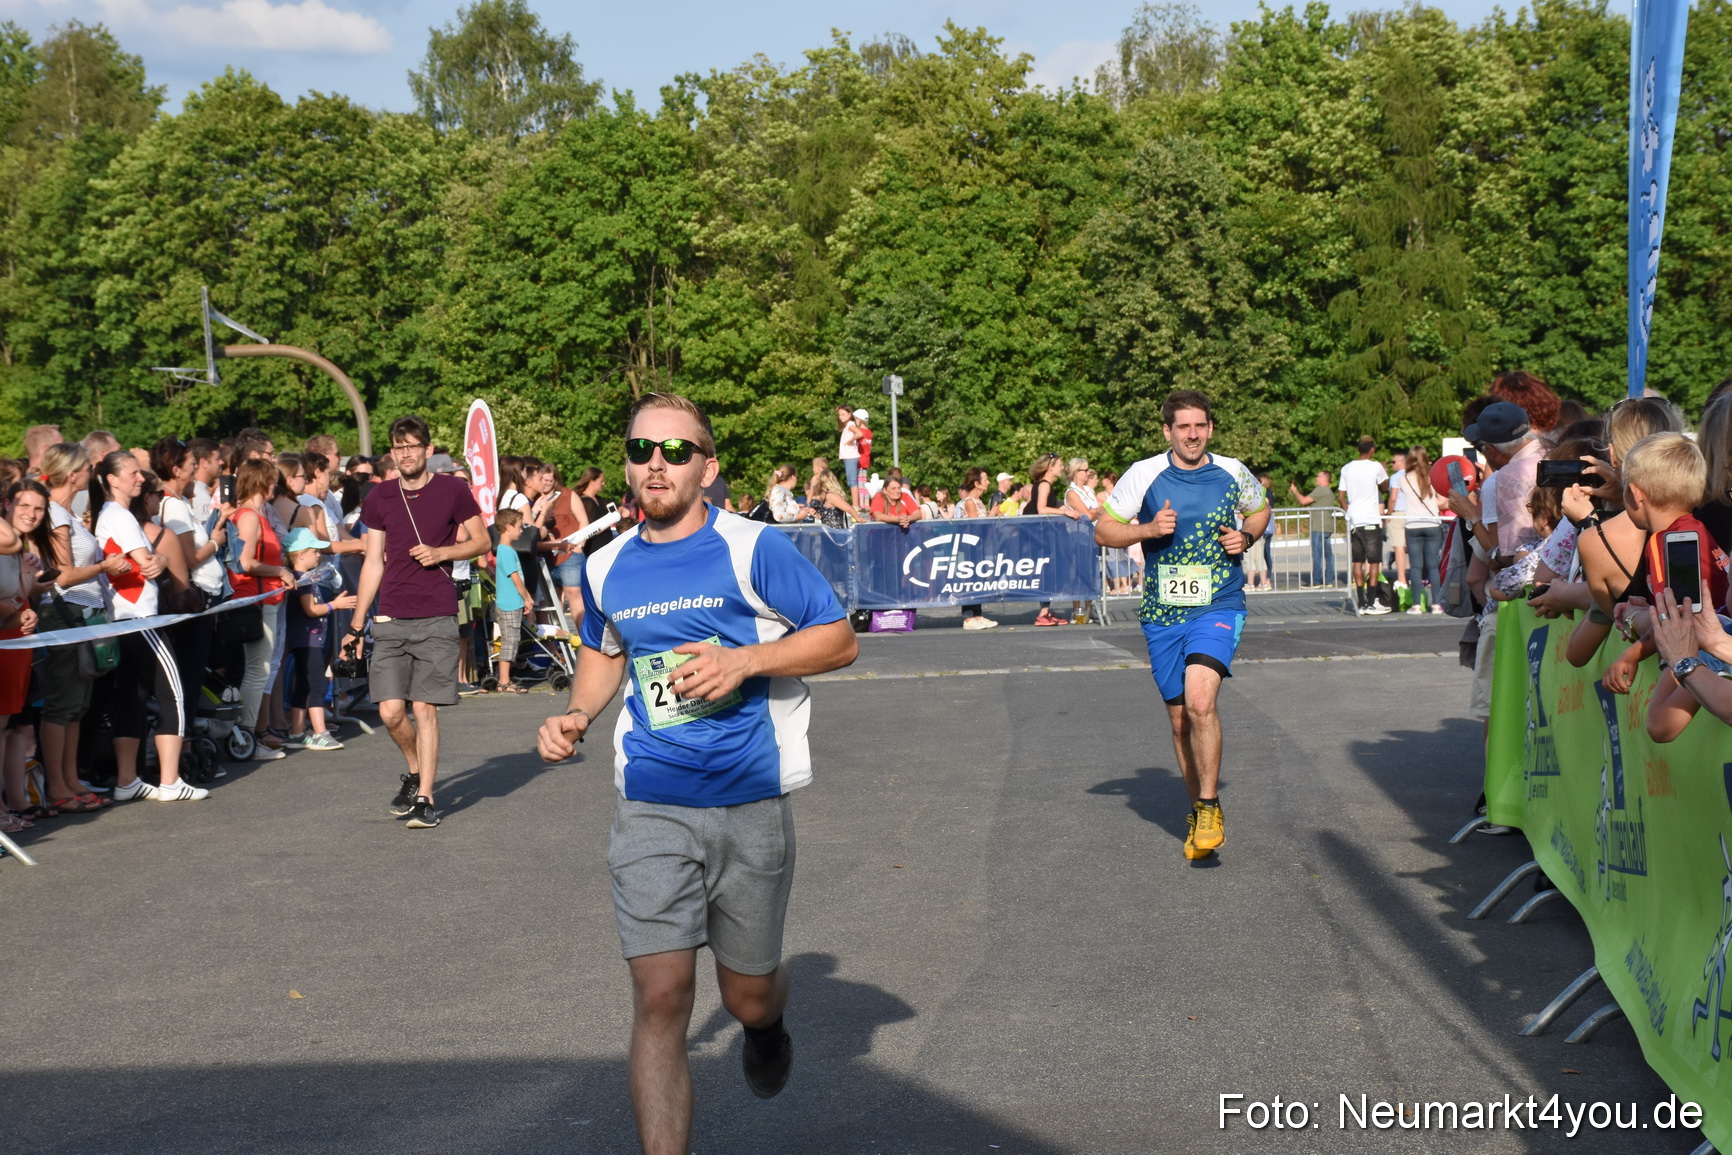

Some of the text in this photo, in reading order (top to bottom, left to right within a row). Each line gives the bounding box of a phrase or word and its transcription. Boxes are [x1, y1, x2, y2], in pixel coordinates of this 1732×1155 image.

[930, 553, 1050, 580] Fischer
[941, 579, 1041, 594] AUTOMOBILE
[1169, 579, 1199, 594] 216
[611, 594, 724, 623] energiegeladen
